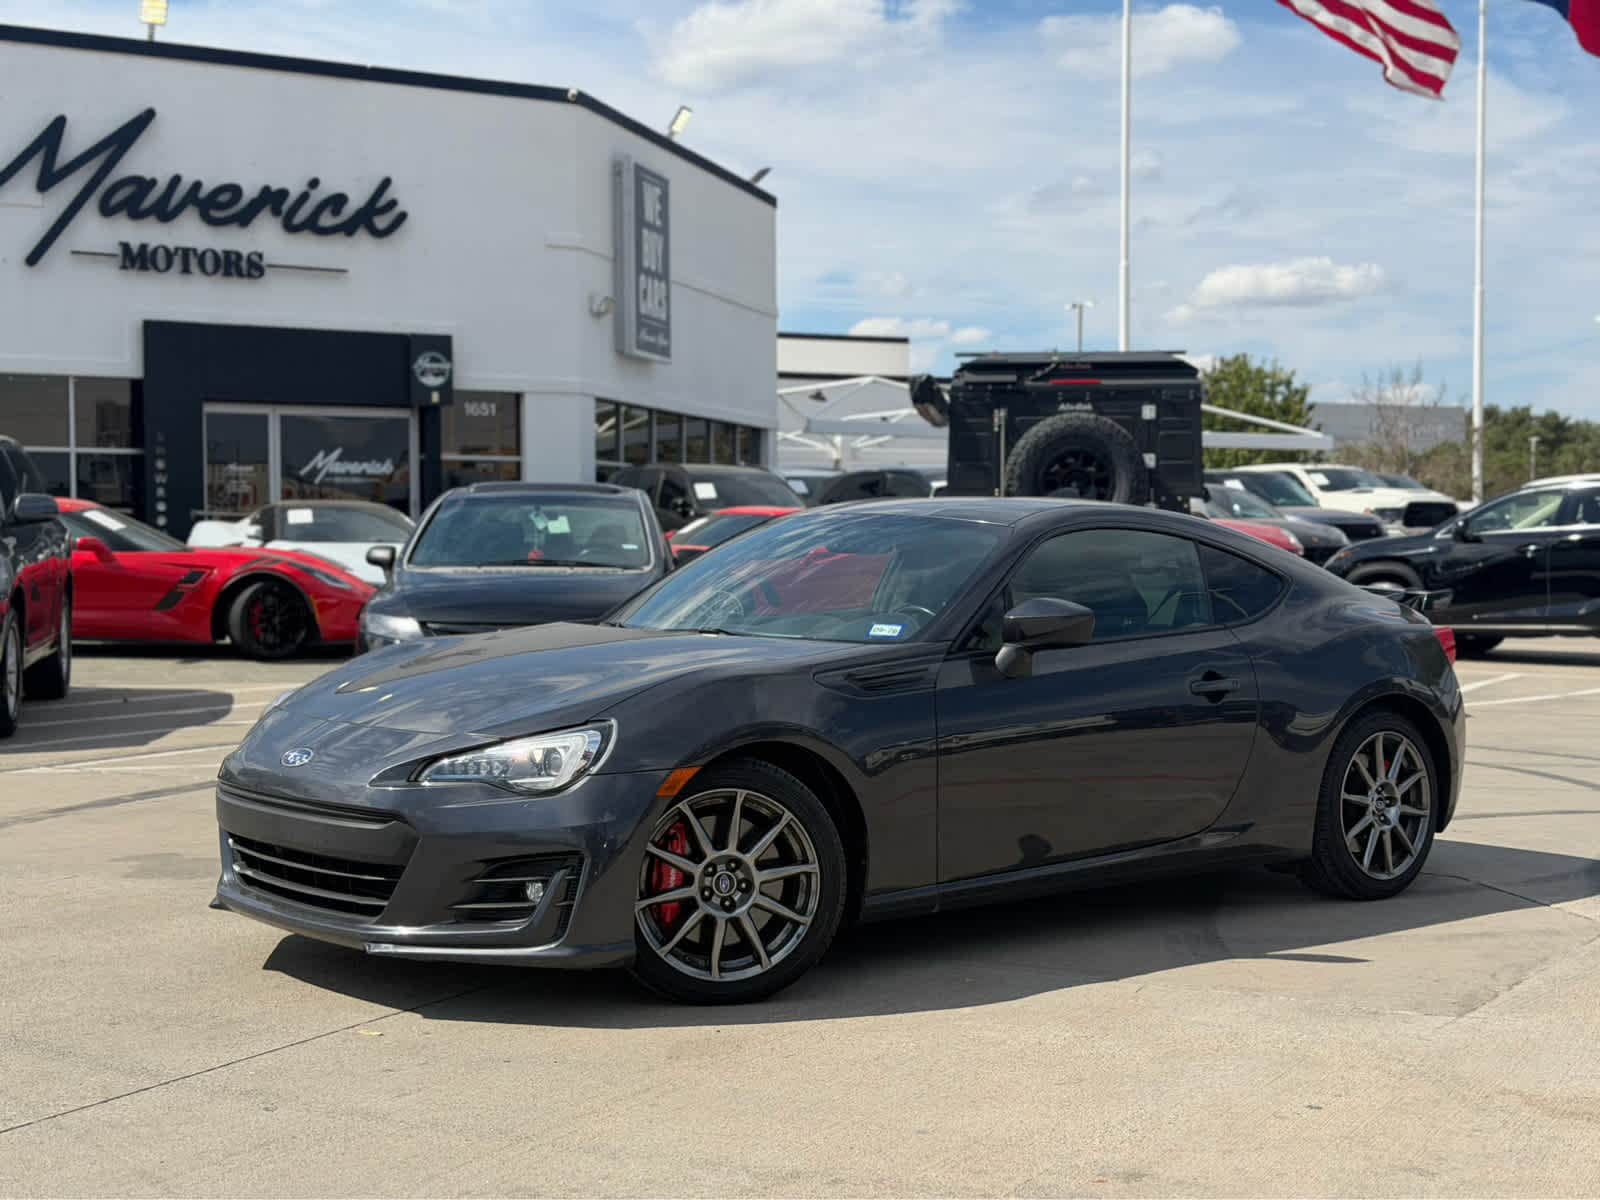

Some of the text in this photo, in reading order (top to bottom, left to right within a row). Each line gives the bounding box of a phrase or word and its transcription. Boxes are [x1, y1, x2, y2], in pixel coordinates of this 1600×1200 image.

[0, 107, 409, 267] Maverick
[641, 180, 664, 228] WE
[119, 241, 266, 279] MOTORS
[640, 226, 665, 275] BUY
[638, 272, 668, 321] CARS
[299, 447, 396, 486] Maverick
